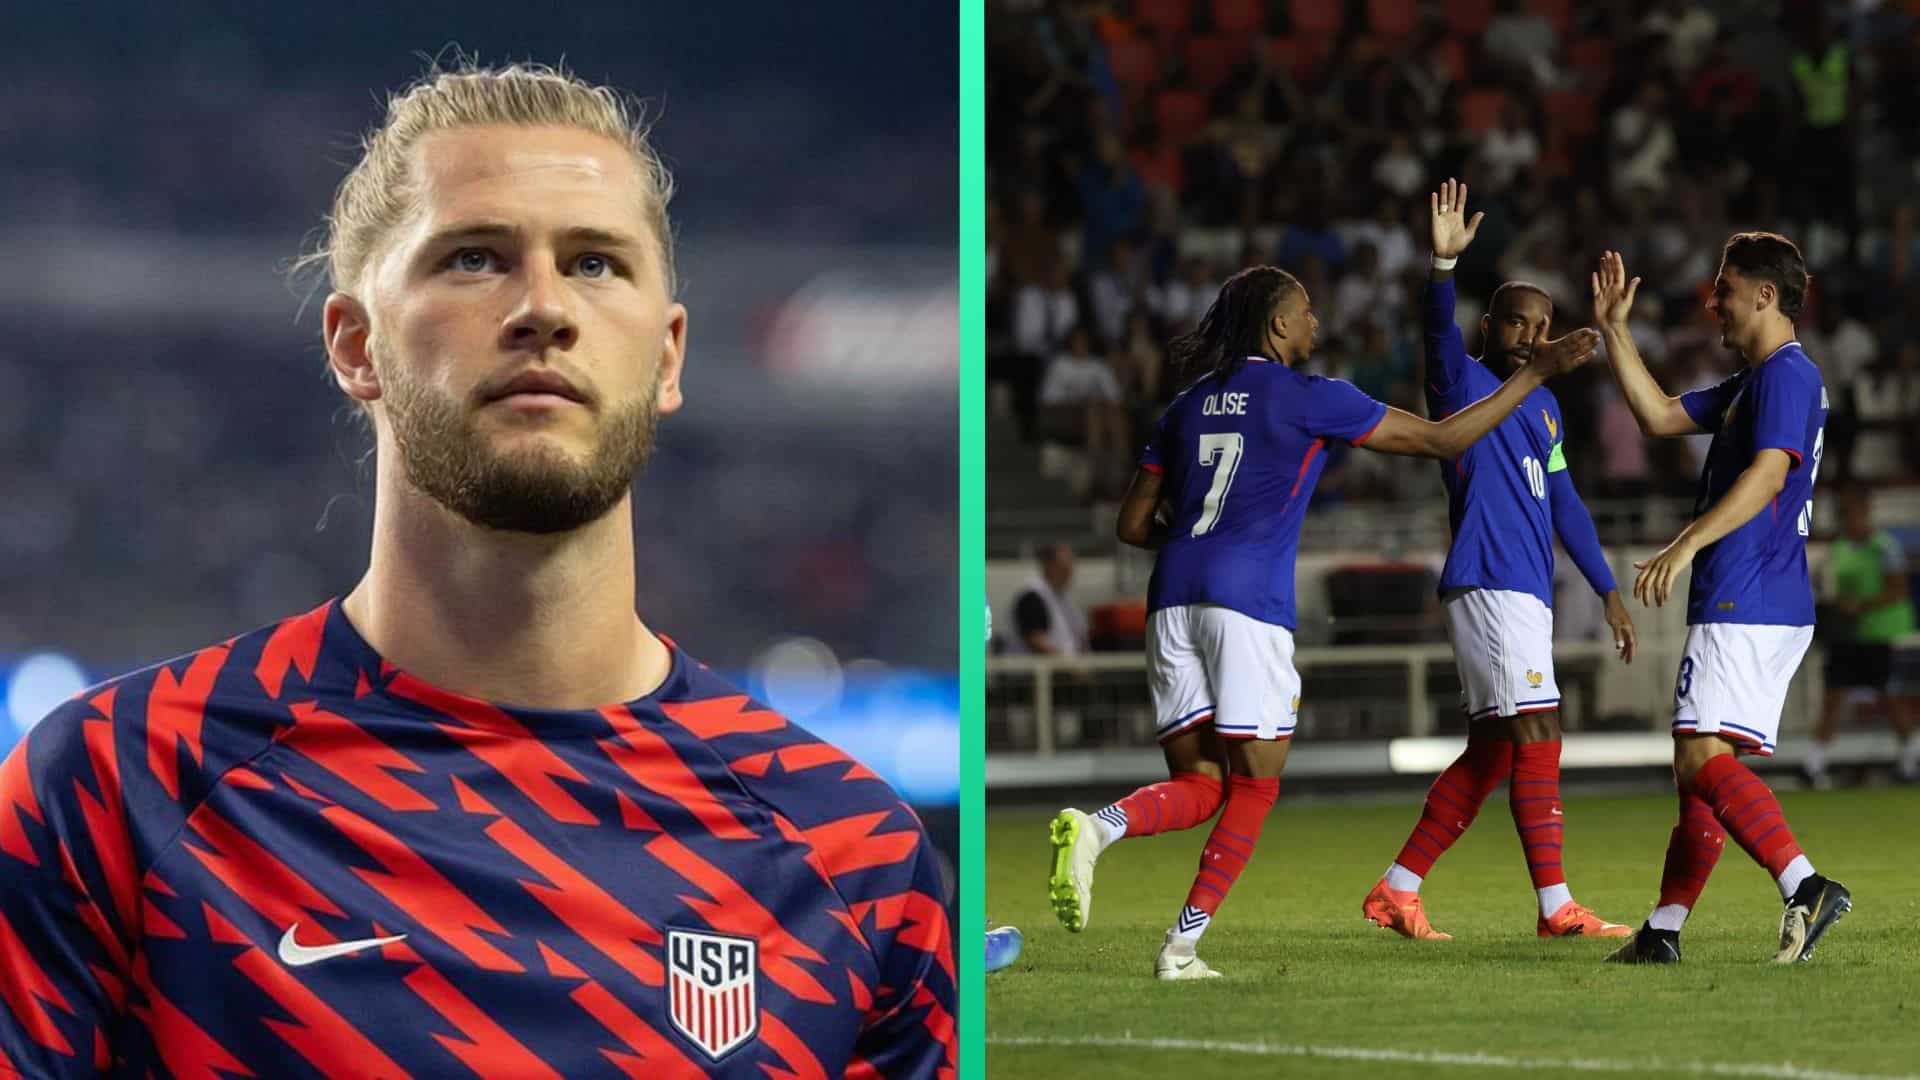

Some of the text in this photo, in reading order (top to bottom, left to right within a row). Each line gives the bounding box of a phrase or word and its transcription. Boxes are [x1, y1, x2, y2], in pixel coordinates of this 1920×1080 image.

[1202, 392, 1249, 415] OLISE
[1191, 432, 1244, 538] 7
[1523, 455, 1545, 500] 10
[672, 935, 749, 987] USA
